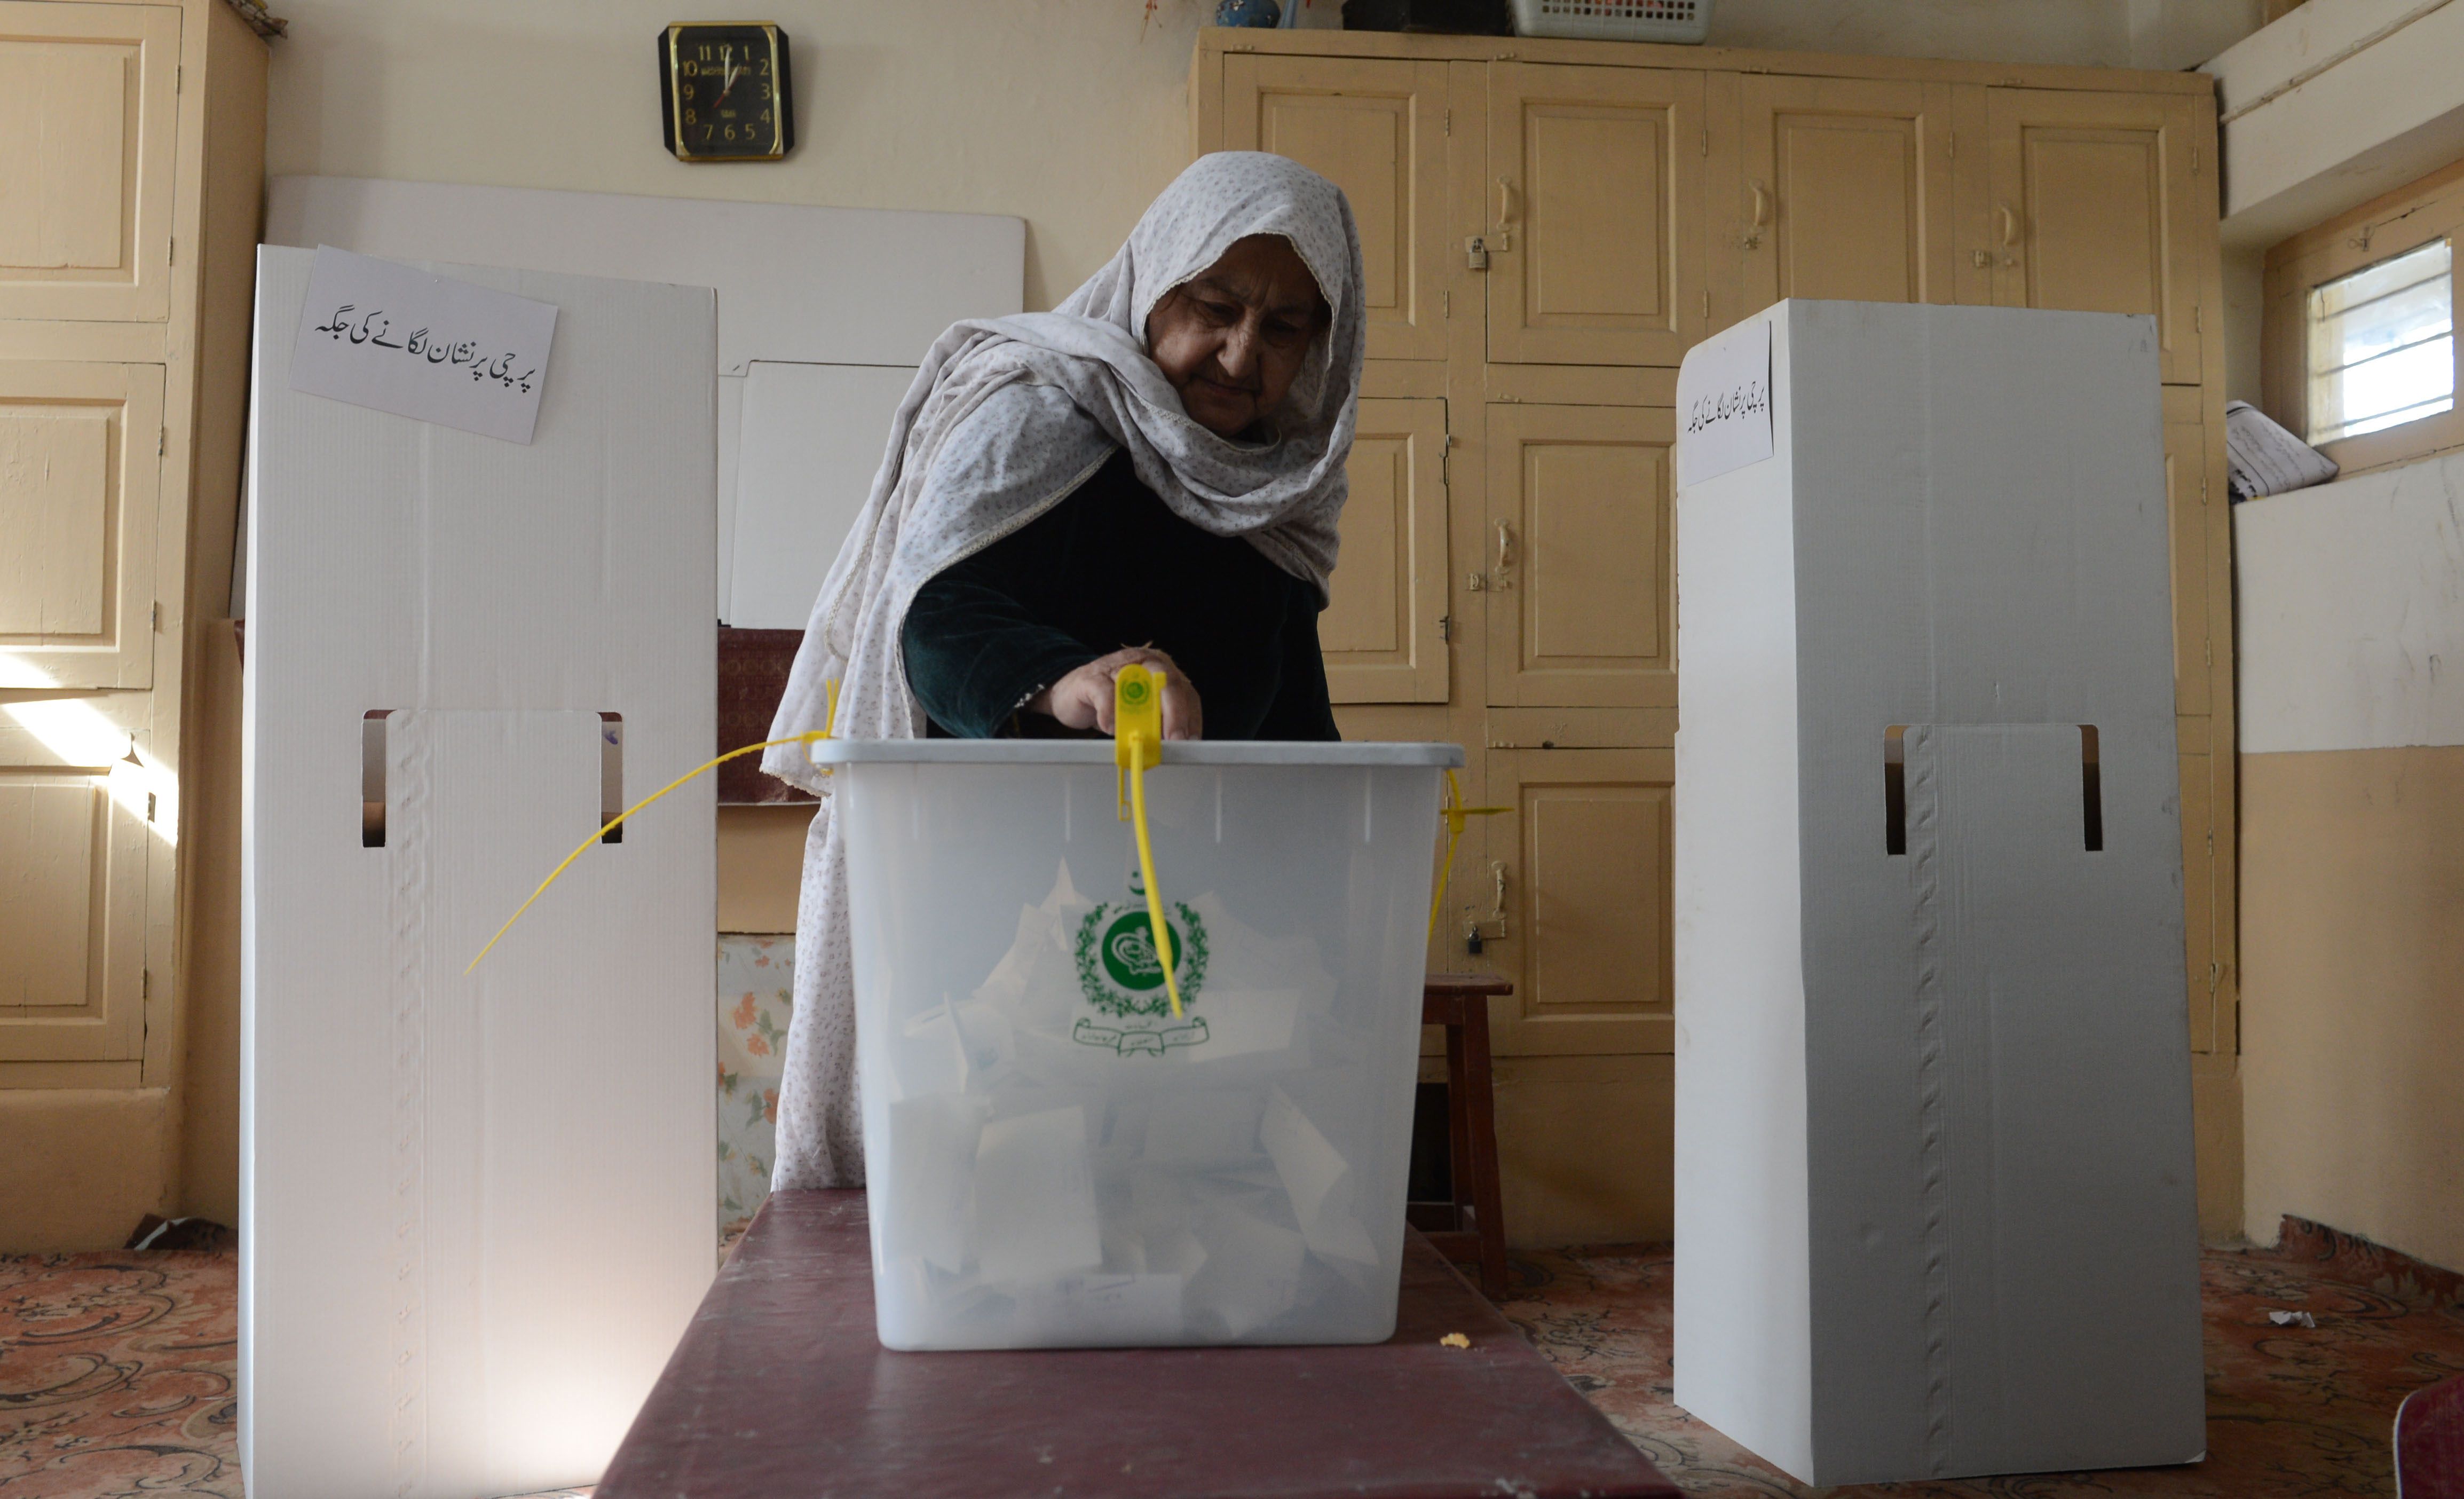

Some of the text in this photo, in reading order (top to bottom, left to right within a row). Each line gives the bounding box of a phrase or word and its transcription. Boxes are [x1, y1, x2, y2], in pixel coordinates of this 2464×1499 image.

[698, 45, 711, 61] 11
[744, 45, 749, 60] 1
[683, 60, 698, 77] 10
[760, 59, 769, 76] 2
[684, 84, 694, 100] 9
[761, 84, 770, 100] 3
[685, 109, 696, 125] 8
[760, 108, 770, 124] 4
[704, 124, 756, 141] 7 6 5
[315, 304, 356, 340] جگہ
[350, 311, 383, 344] کی
[371, 320, 429, 354] لگانے
[427, 342, 477, 365] نشان
[469, 356, 488, 381] پر
[1698, 393, 1708, 431] کی
[1724, 386, 1741, 420] نشان
[1740, 394, 1746, 419] پر
[1687, 399, 1699, 434] جگہ
